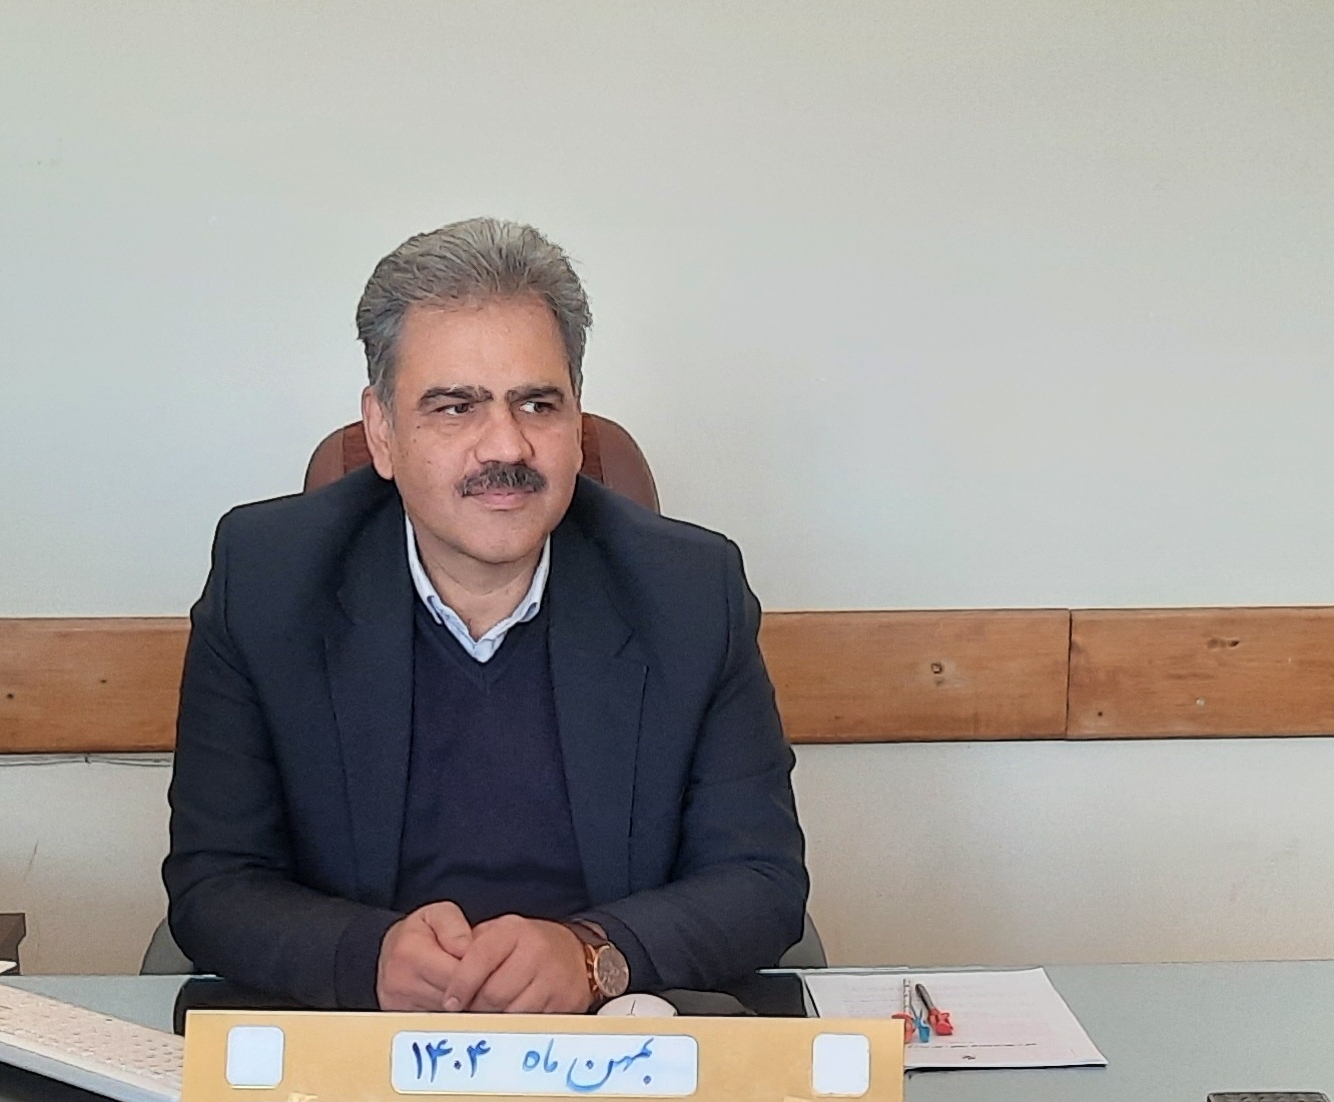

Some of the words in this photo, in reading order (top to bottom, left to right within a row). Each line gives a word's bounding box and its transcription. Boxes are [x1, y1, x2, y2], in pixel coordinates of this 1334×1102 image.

[412, 1038, 491, 1083] ۱۴۰۴
[522, 1038, 558, 1073] ماه
[566, 1037, 655, 1092] بهمن
